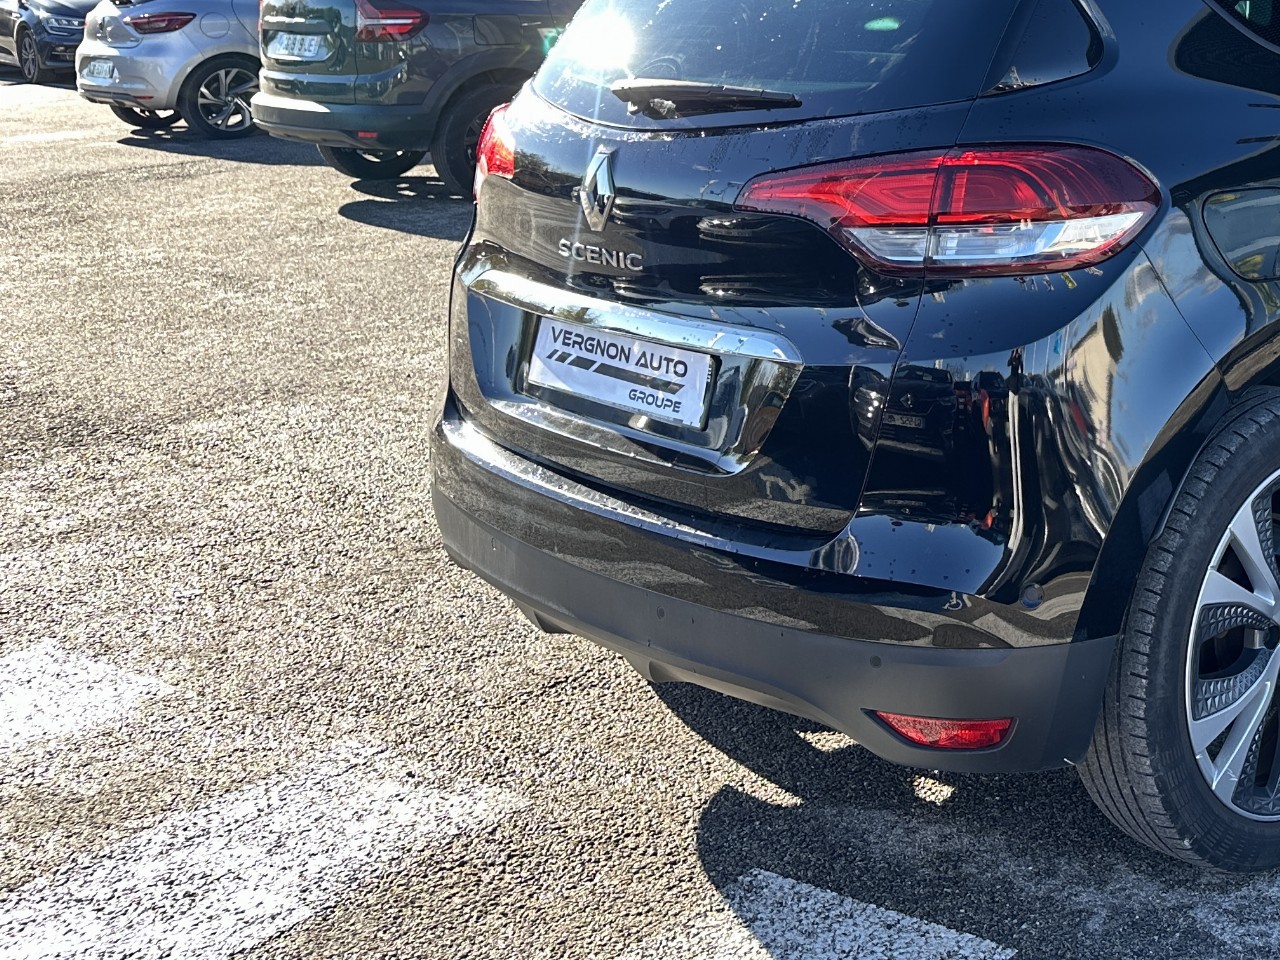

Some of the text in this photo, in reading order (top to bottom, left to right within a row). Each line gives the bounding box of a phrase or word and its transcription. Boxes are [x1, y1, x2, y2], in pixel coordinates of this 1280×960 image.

[558, 238, 644, 272] SCENIC
[551, 325, 688, 378] VERGNON AUTO
[628, 388, 682, 414] GROUPE
